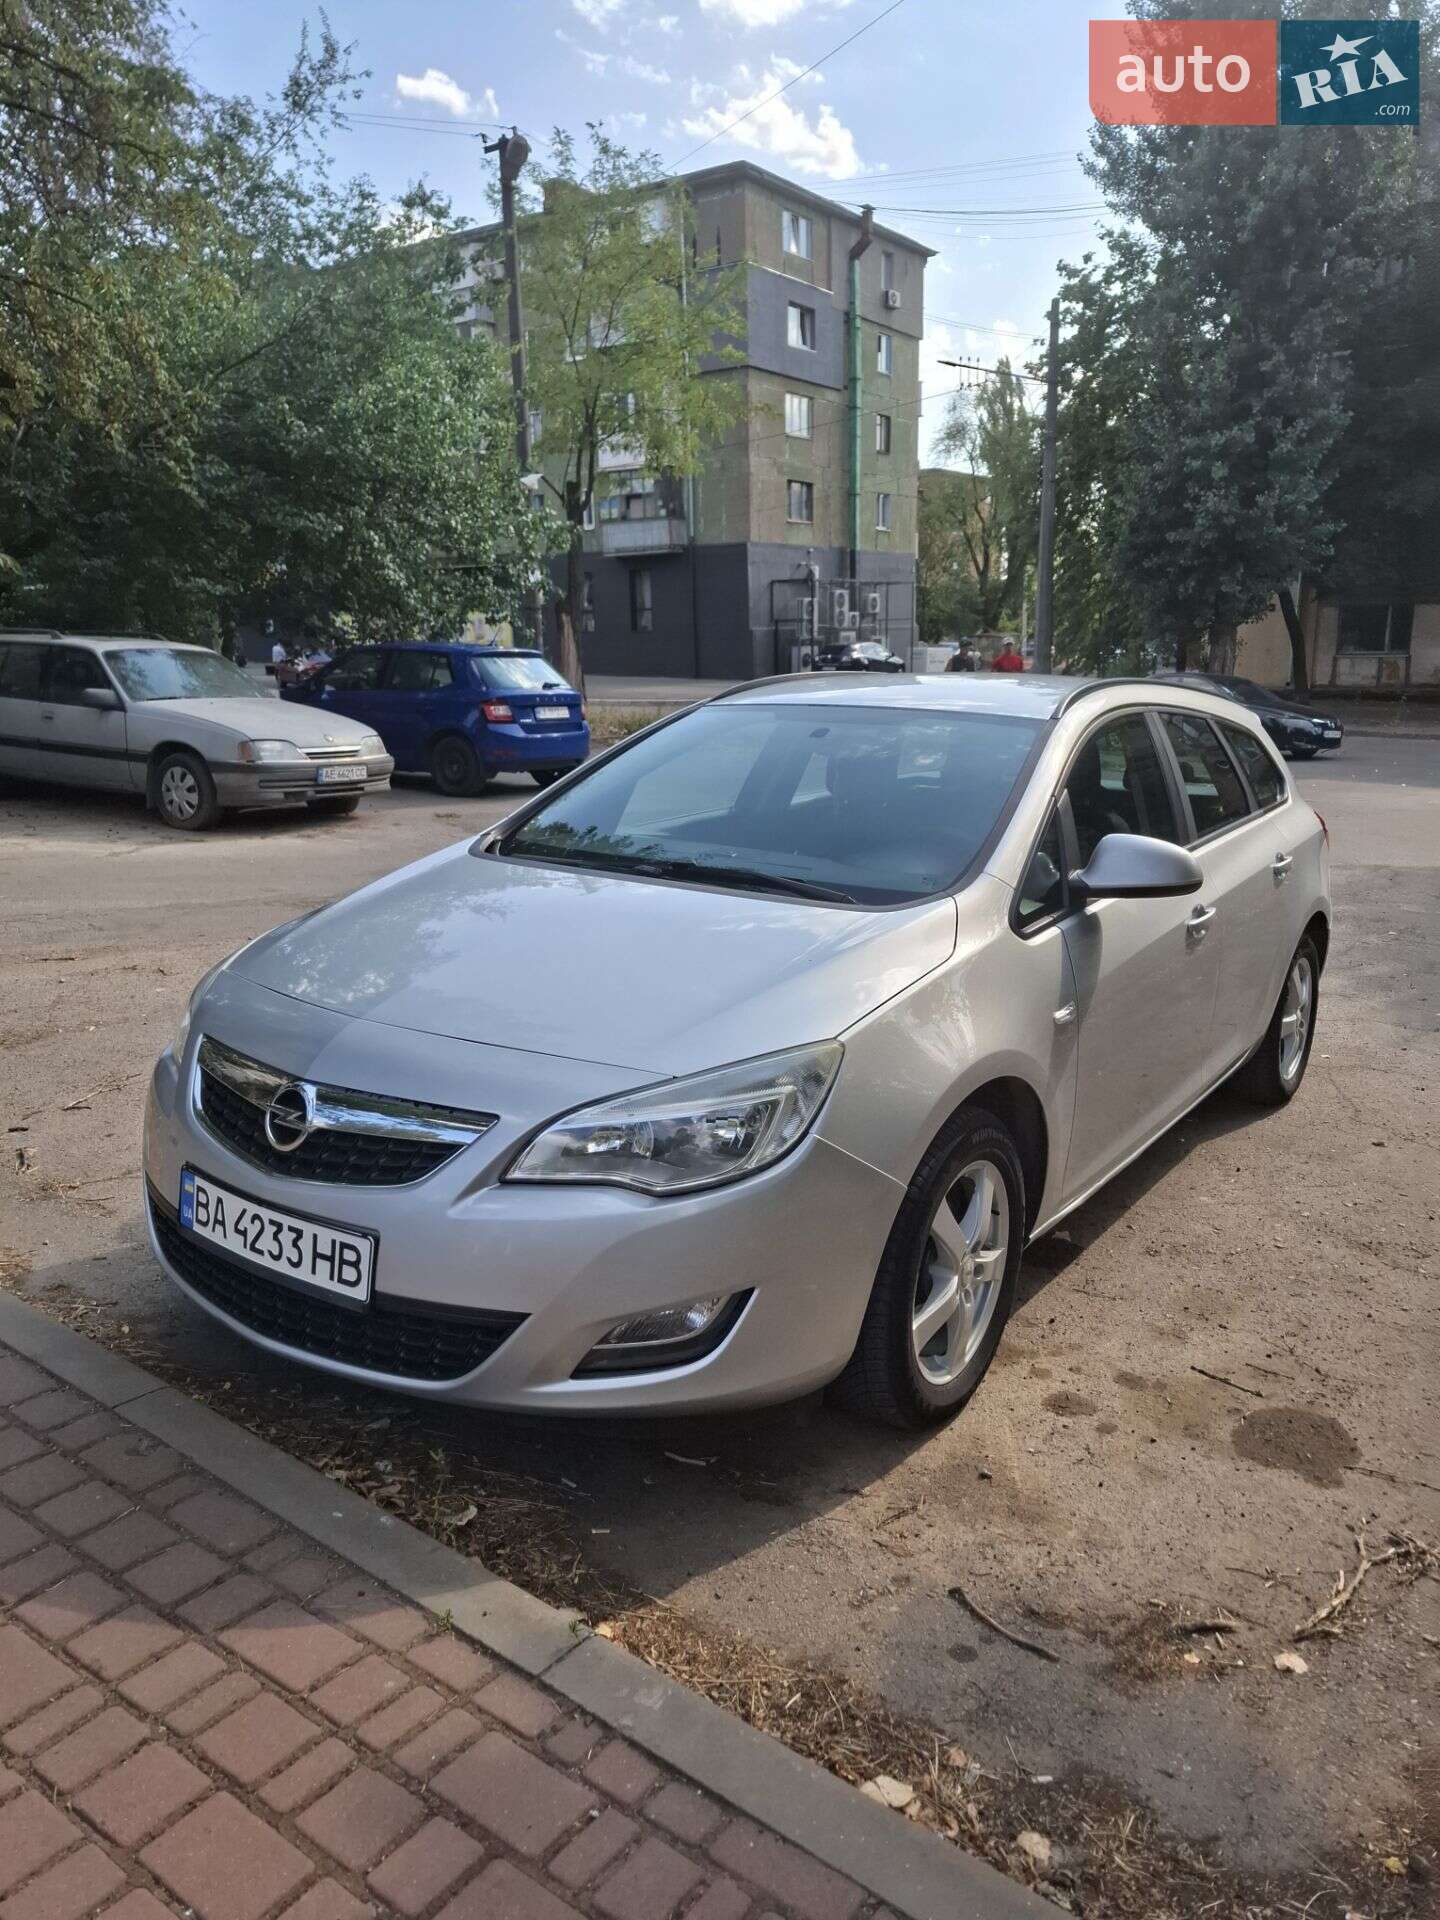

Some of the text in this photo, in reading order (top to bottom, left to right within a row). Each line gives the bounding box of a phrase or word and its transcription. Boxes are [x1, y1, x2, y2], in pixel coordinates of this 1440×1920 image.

[195, 1184, 362, 1288] BA 4233 HB
